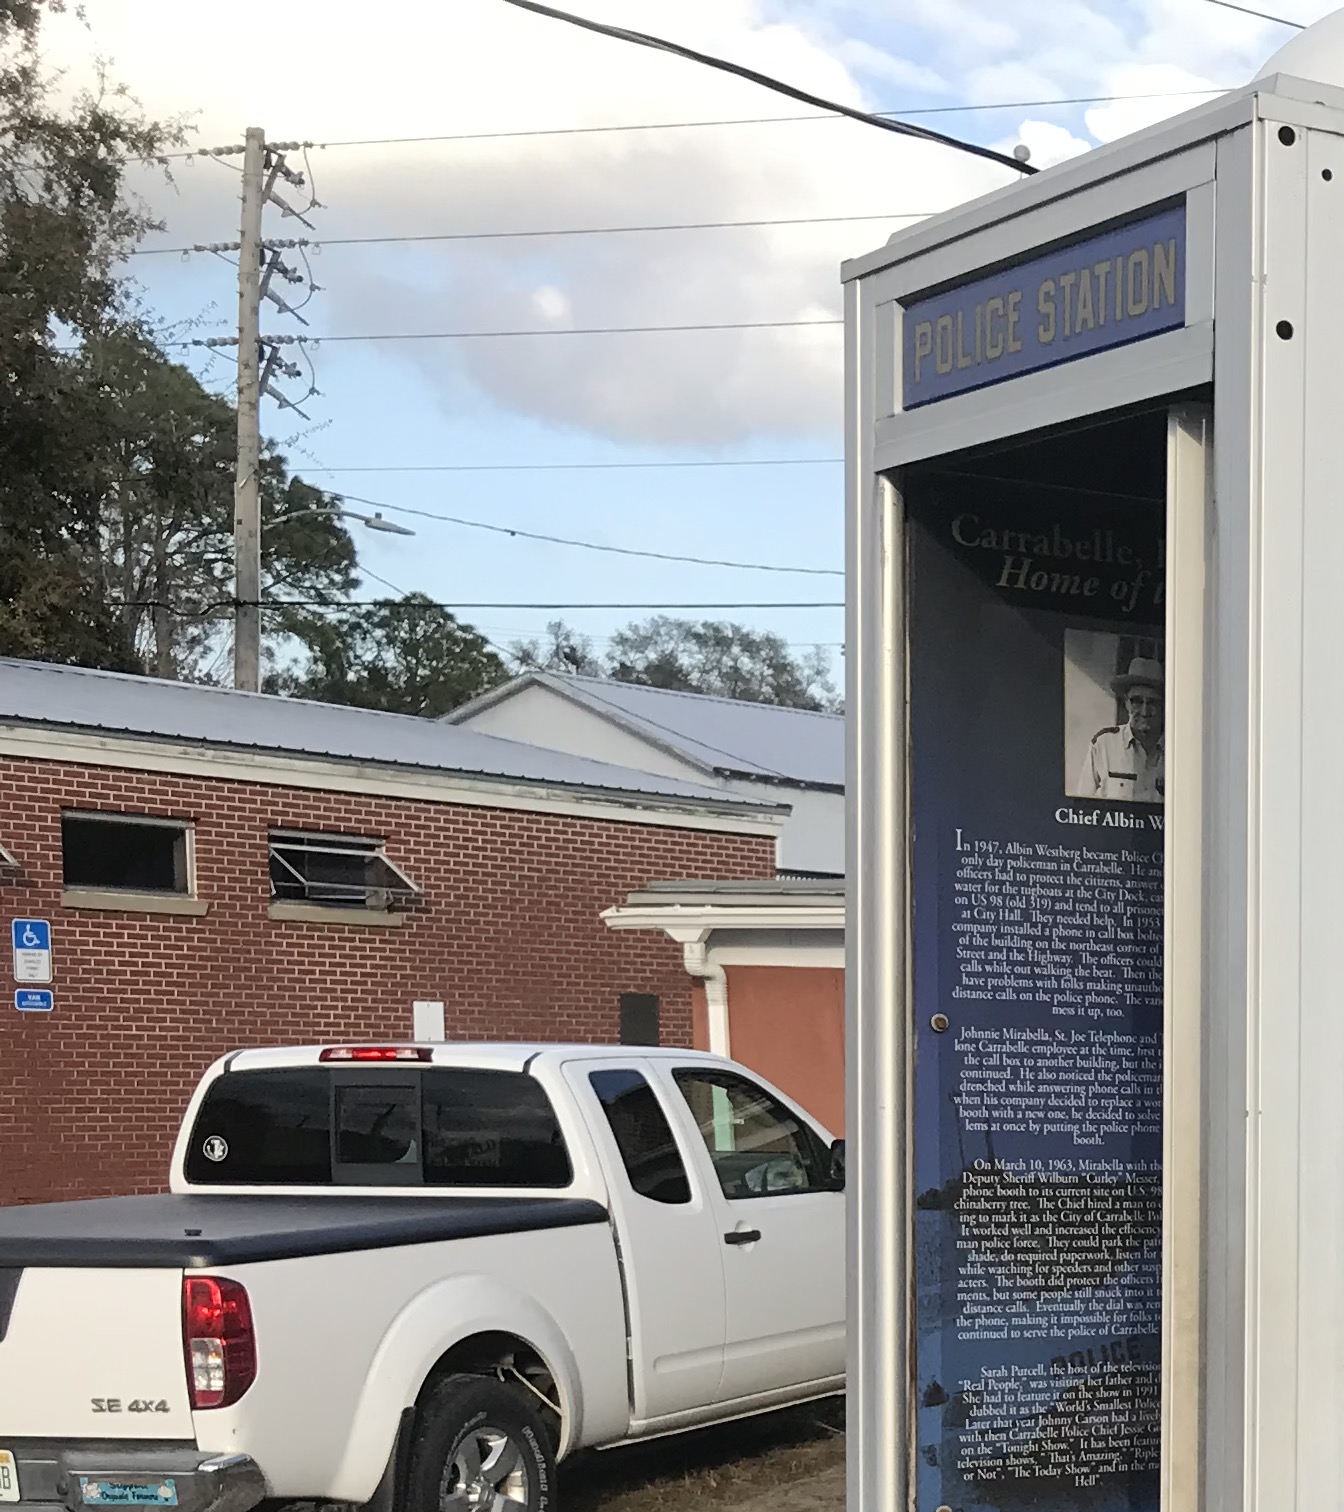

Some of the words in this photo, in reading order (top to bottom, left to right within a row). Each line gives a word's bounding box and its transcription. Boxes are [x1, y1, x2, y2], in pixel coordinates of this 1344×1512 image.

[913, 290, 1023, 385] POLICE
[1037, 238, 1176, 345] STATION
[951, 513, 1143, 569] Carrabelle,
[995, 555, 1099, 597] Home
[1110, 569, 1152, 613] of
[1055, 807, 1101, 826] Chief
[1101, 811, 1145, 829] Albin
[957, 867, 992, 879] officers
[995, 869, 1013, 881] had
[1016, 872, 1027, 881] to
[1029, 874, 1064, 885] protect
[1067, 873, 1082, 885] the
[961, 909, 971, 918] at
[974, 908, 996, 922] City
[1030, 910, 1054, 925] They
[1057, 912, 1090, 924] needed
[1123, 915, 1133, 926] In
[1138, 916, 1161, 927] 1953
[956, 948, 985, 959] Street
[988, 949, 1006, 960] and
[1009, 950, 1025, 961] the
[1080, 953, 1098, 964] The
[1100, 954, 1134, 966] officers
[1136, 956, 1163, 967] could
[960, 961, 982, 972] calls
[985, 962, 1012, 974] while
[1014, 965, 1031, 974] out
[1034, 964, 1072, 979] walking
[1075, 966, 1090, 977] the
[1093, 966, 1115, 978] beat.
[1122, 968, 1145, 979] Then
[1149, 969, 1162, 980] the
[1052, 1006, 1075, 1015] mess
[1078, 1005, 1085, 1015] it
[1088, 1007, 1103, 1019] up,
[1106, 1007, 1125, 1016] too.
[960, 1028, 1000, 1041] Johnnie
[1003, 1030, 1052, 1043] Mirabella,
[1055, 1031, 1067, 1041] St.
[1071, 1031, 1086, 1043] Joe
[1091, 1031, 1137, 1046] Telephone
[1140, 1032, 1157, 1043] and
[954, 1040, 976, 1052] lone
[979, 1041, 1029, 1053] Carrabelle
[1032, 1043, 1078, 1057] employee
[1080, 1045, 1089, 1054] at
[1092, 1044, 1107, 1055] the
[964, 1054, 980, 1065] the
[983, 1055, 1000, 1065] call
[1003, 1055, 1021, 1066] box
[1024, 1057, 1035, 1066] to
[1037, 1056, 1074, 1067] another
[1077, 1056, 1120, 1071] building,
[1122, 1057, 1138, 1068] but
[1141, 1058, 1157, 1069] the
[960, 1081, 1006, 1092] drenched
[1009, 1081, 1035, 1092] while
[1038, 1083, 1086, 1096] answering
[1089, 1083, 1118, 1097] phone
[1120, 1083, 1141, 1094] calls
[1144, 1084, 1154, 1094] in
[960, 1106, 989, 1117] booth
[992, 1107, 1014, 1118] with
[1017, 1110, 1022, 1118] a
[1025, 1110, 1045, 1118] new
[1047, 1110, 1069, 1120] one,
[1072, 1108, 1083, 1119] he
[1086, 1108, 1122, 1119] decided
[1125, 1110, 1135, 1119] to
[1137, 1109, 1161, 1120] solve
[1073, 1134, 1105, 1145] booth.
[963, 1173, 1000, 1186] Deputy
[1003, 1172, 1034, 1183] Sheriff
[1038, 1172, 1079, 1183] Wilburn
[963, 1185, 994, 1199] phone
[997, 1185, 1026, 1196] booth
[1029, 1187, 1039, 1196] to
[1042, 1186, 1054, 1196] its
[1056, 1187, 1090, 1196] current
[1093, 1186, 1110, 1196] site
[1112, 1188, 1125, 1196] on
[968, 1250, 998, 1263] shade,
[1001, 1250, 1015, 1261] do
[1017, 1250, 1057, 1264] required
[1116, 1249, 1141, 1260] listen
[1144, 1248, 1157, 1259] for
[957, 1327, 1007, 1339] continued
[1011, 1329, 1021, 1338] to
[1023, 1329, 1047, 1338] serve
[1050, 1326, 1065, 1337] the
[1068, 1325, 1096, 1339] police
[1099, 1324, 1108, 1335] of
[1111, 1323, 1159, 1335] Carrabelle
[1029, 1380, 1048, 1388] was
[1050, 1377, 1085, 1390] visiting
[1087, 1375, 1102, 1386] her
[1105, 1374, 1132, 1386] father
[1135, 1373, 1153, 1384] and
[962, 1393, 980, 1404] She
[983, 1392, 1002, 1403] had
[1004, 1393, 1015, 1402] to
[1017, 1391, 1051, 1402] feature
[1053, 1390, 1060, 1400] it
[1063, 1391, 1076, 1400] on
[1079, 1388, 1093, 1399] the
[1096, 1387, 1120, 1398] show
[1123, 1387, 1132, 1397] in
[91, 1398, 122, 1413] SE
